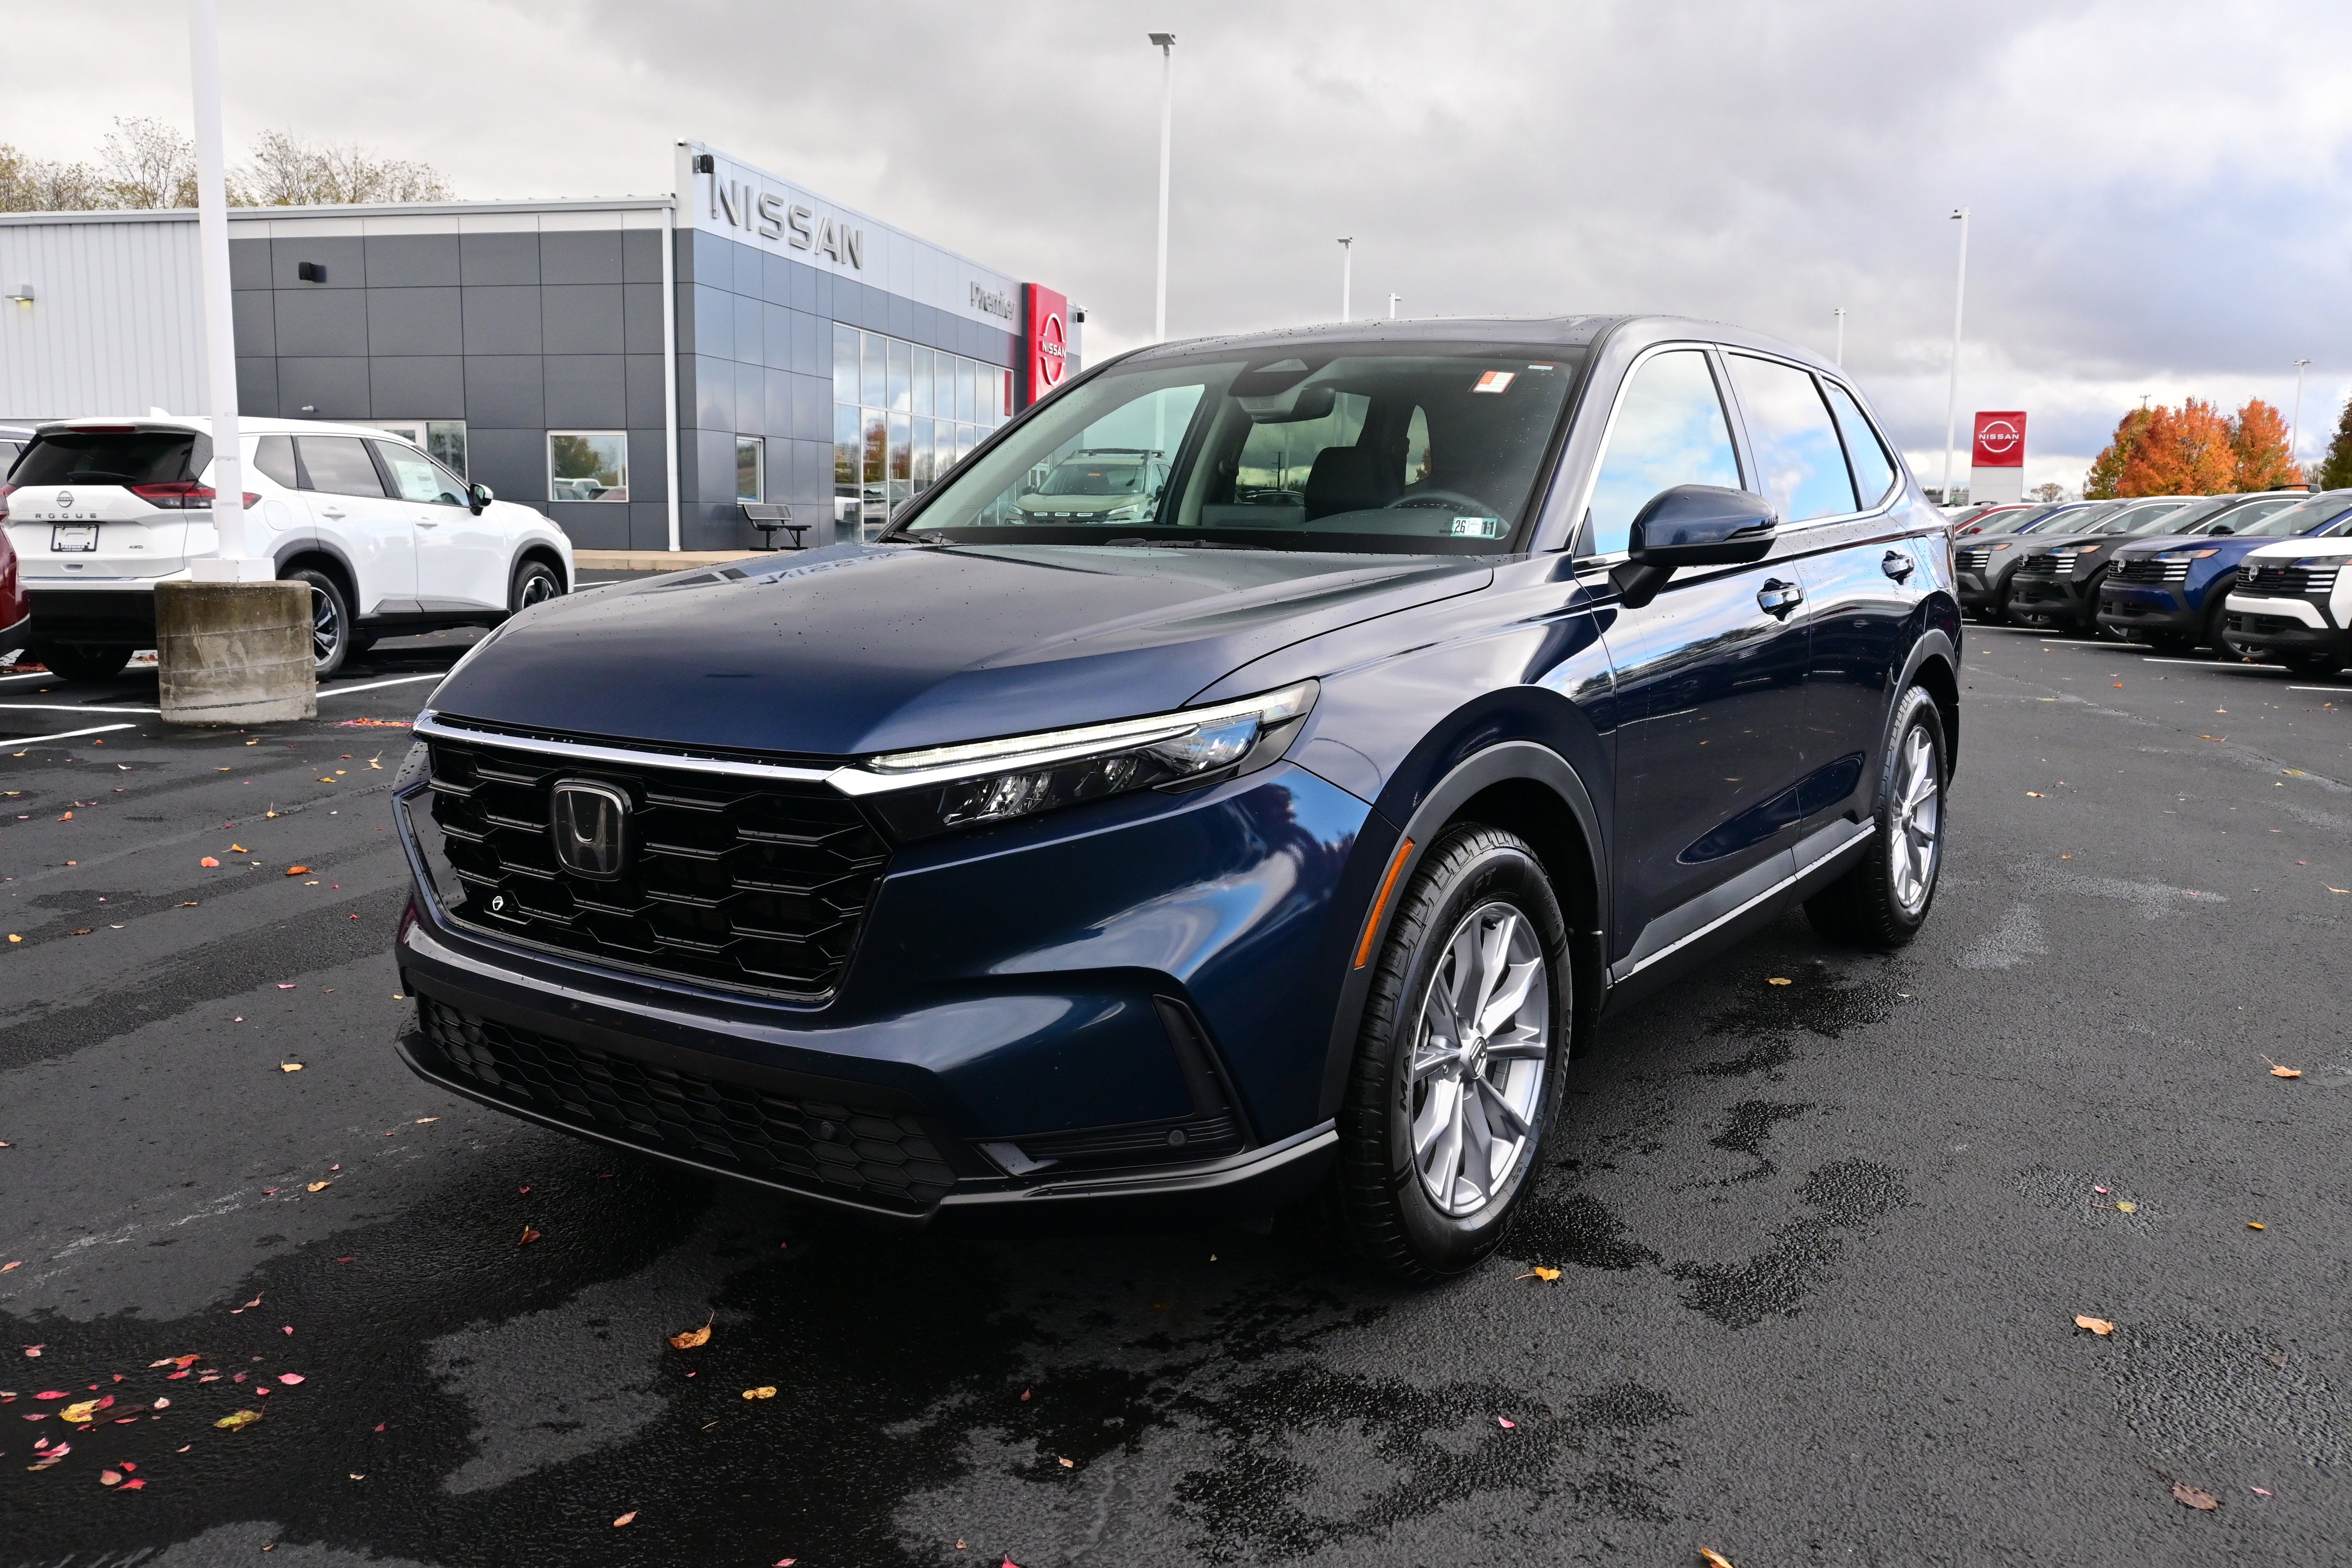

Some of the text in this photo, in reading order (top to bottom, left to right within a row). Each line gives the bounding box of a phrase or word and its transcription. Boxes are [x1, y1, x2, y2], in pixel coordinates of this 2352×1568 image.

[712, 172, 863, 269] NISSAN
[971, 281, 1016, 320] Premier
[1042, 340, 1066, 359] NISSAN
[1455, 520, 1466, 533] 26
[1483, 521, 1494, 534] 11
